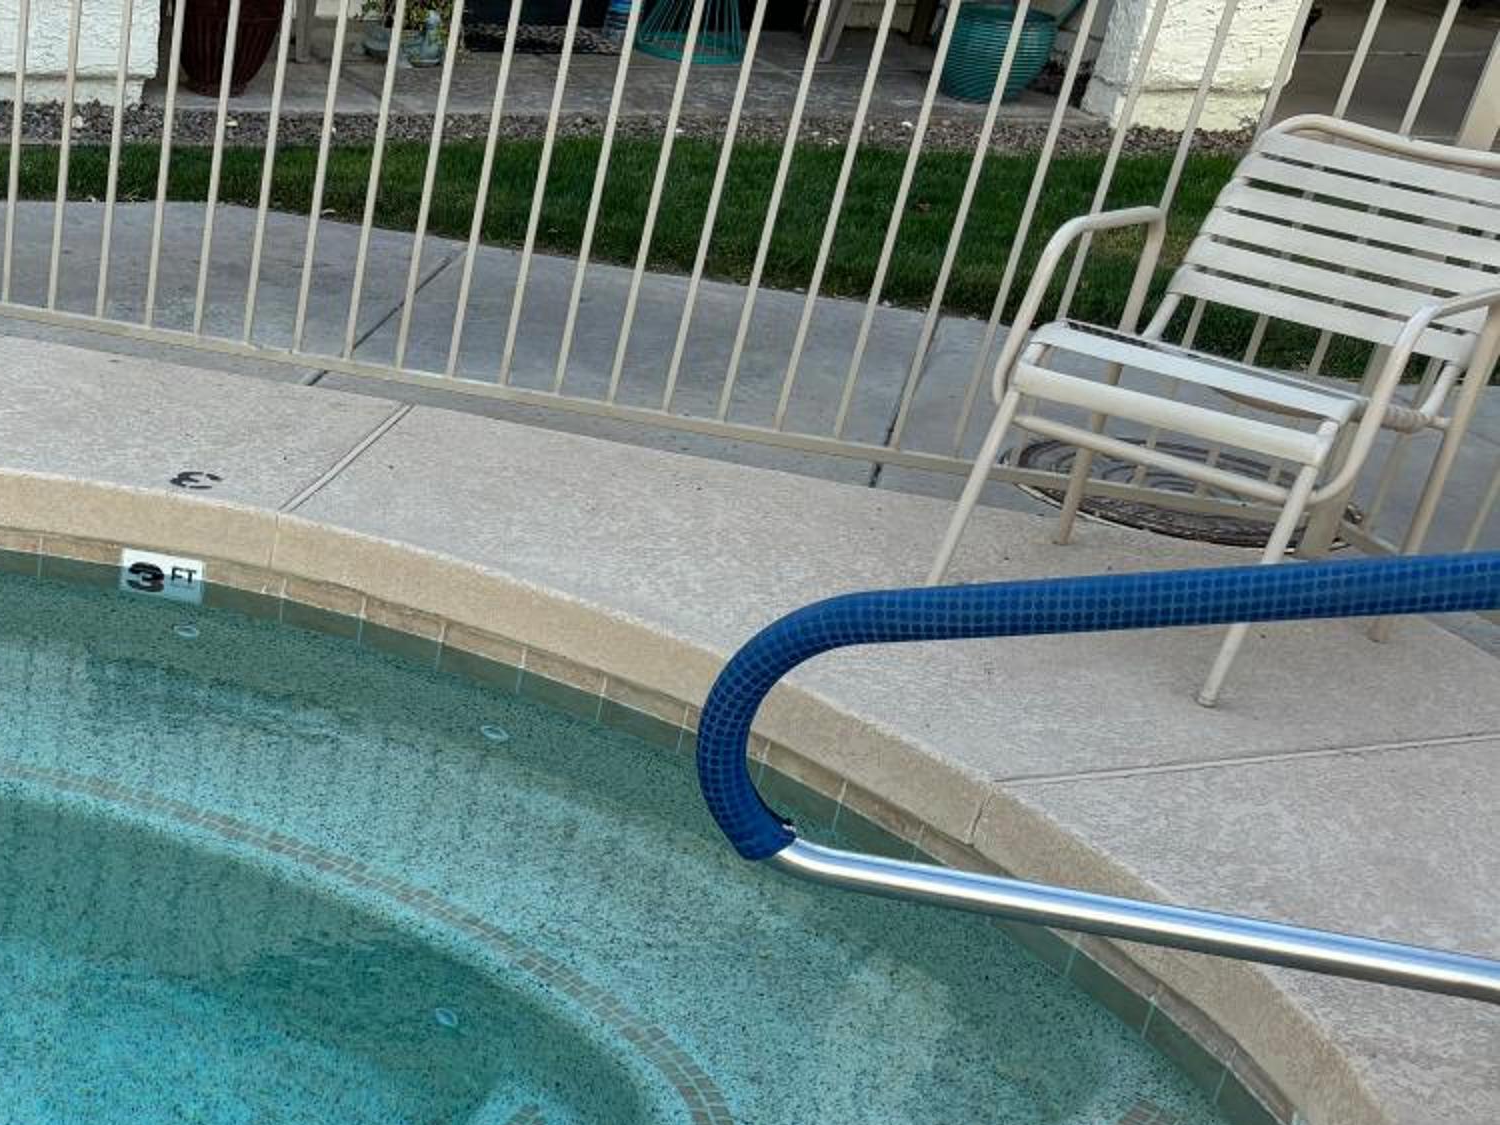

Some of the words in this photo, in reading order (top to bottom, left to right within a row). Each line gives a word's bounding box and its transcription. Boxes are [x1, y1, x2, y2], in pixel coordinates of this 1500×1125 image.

[170, 471, 223, 489] 3
[127, 561, 165, 592] 3
[171, 566, 197, 584] FT
